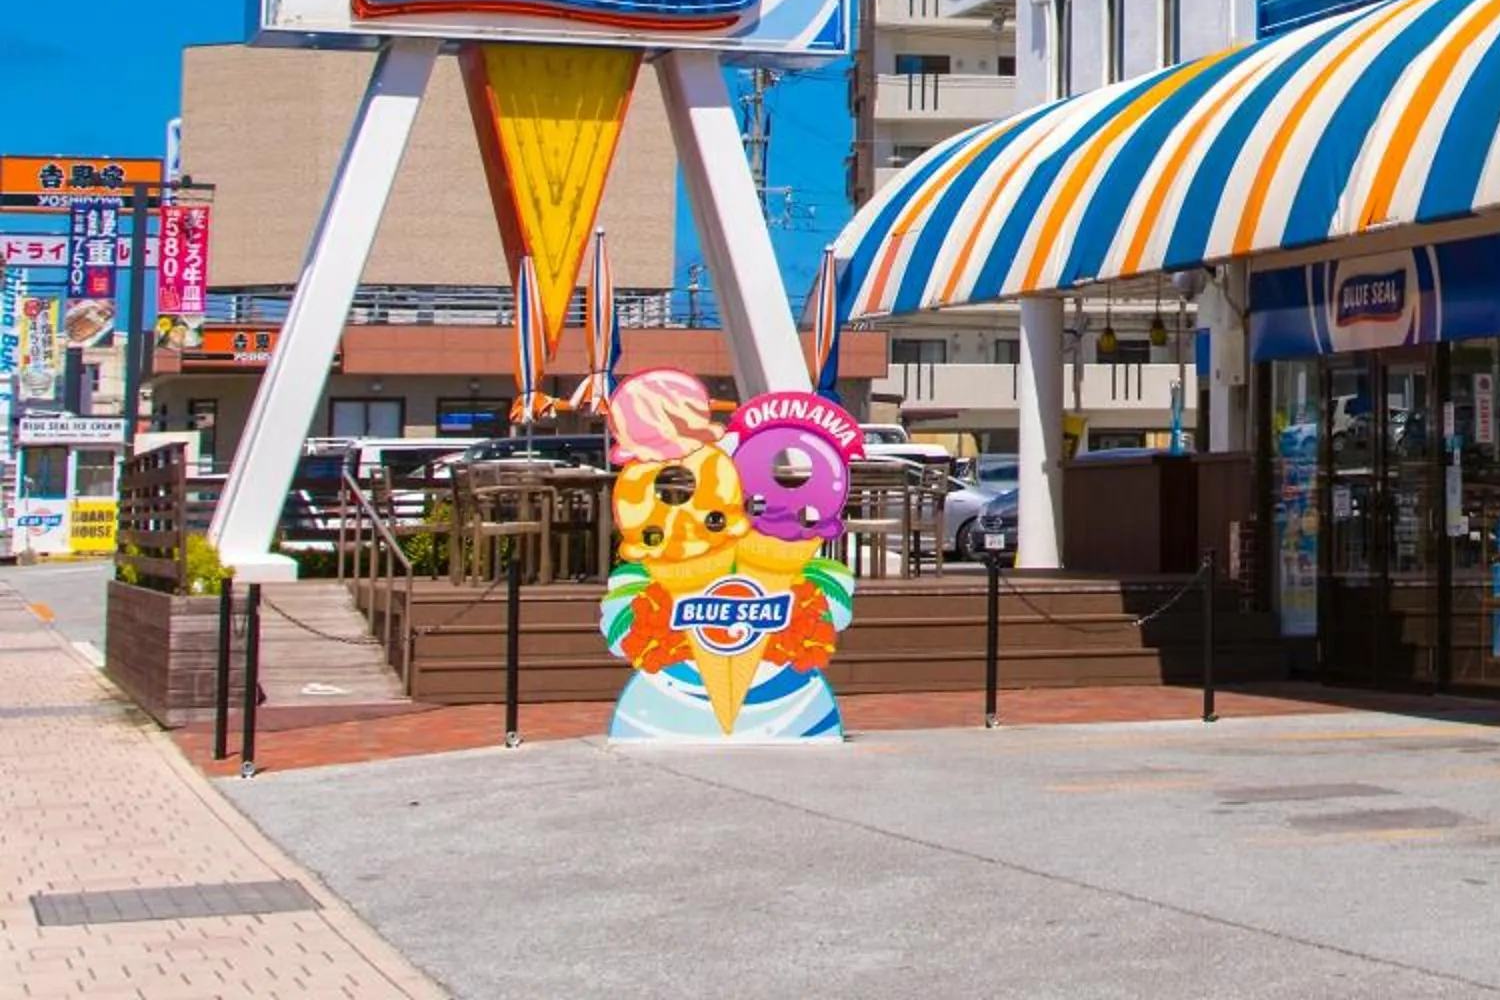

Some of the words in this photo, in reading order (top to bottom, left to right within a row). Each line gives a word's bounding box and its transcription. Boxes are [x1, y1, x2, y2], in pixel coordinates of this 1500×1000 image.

[1343, 283, 1369, 309] BLUE
[1371, 280, 1397, 304] SEAL
[744, 397, 858, 448] OKINAWA
[72, 526, 112, 538] HOUSE
[682, 601, 730, 622] BLUE
[736, 603, 784, 622] SEAL
